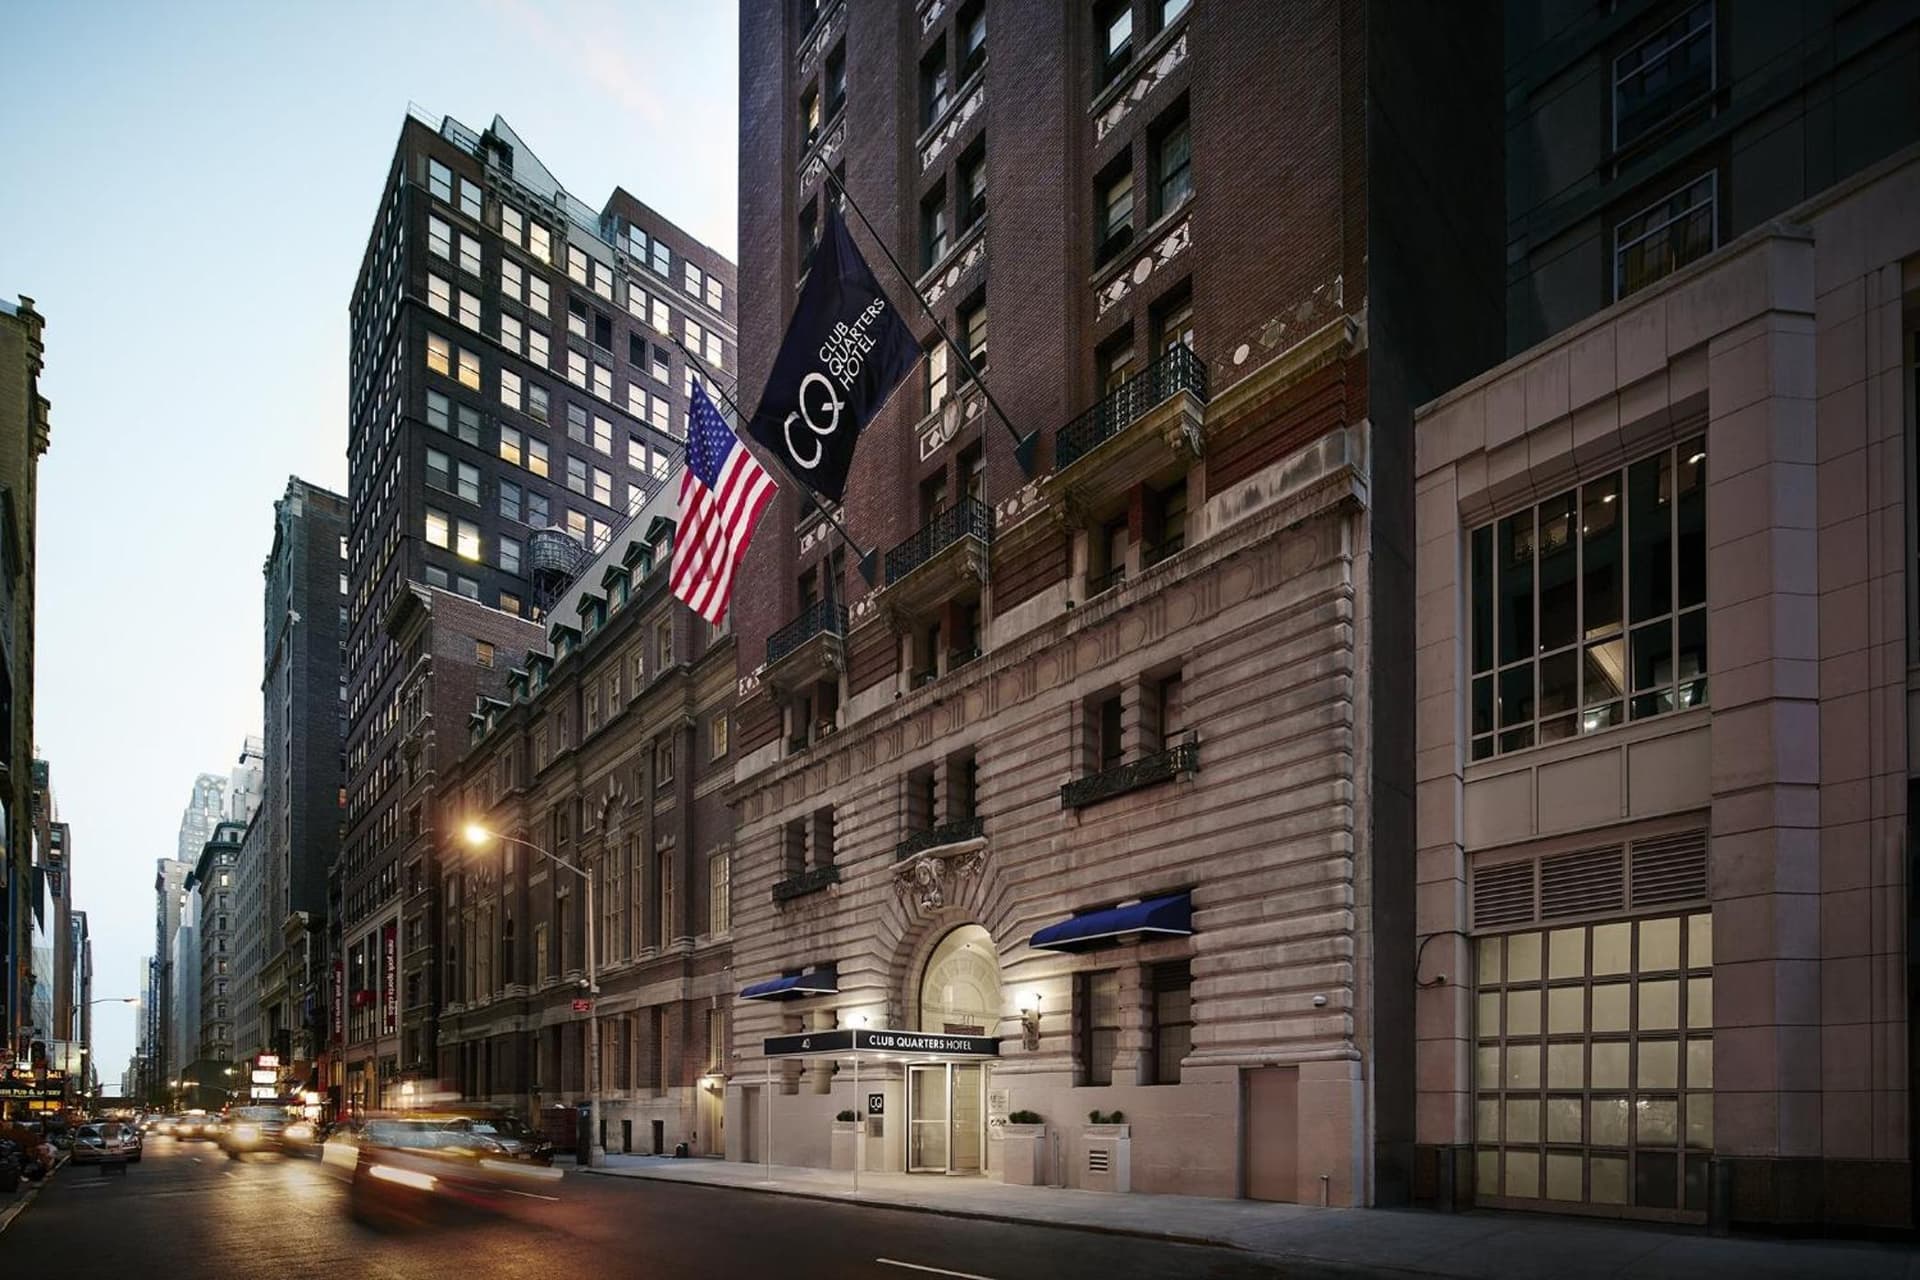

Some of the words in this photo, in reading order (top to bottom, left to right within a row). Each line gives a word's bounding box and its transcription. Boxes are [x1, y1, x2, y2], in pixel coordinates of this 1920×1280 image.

[818, 320, 850, 364] CLUB
[828, 297, 886, 377] QUARTERS
[838, 334, 877, 392] HOTEL
[784, 372, 846, 470] CQ
[869, 1034, 894, 1047] CLUB
[896, 1036, 945, 1049] QUARTERS
[946, 1040, 972, 1051] HOTEL
